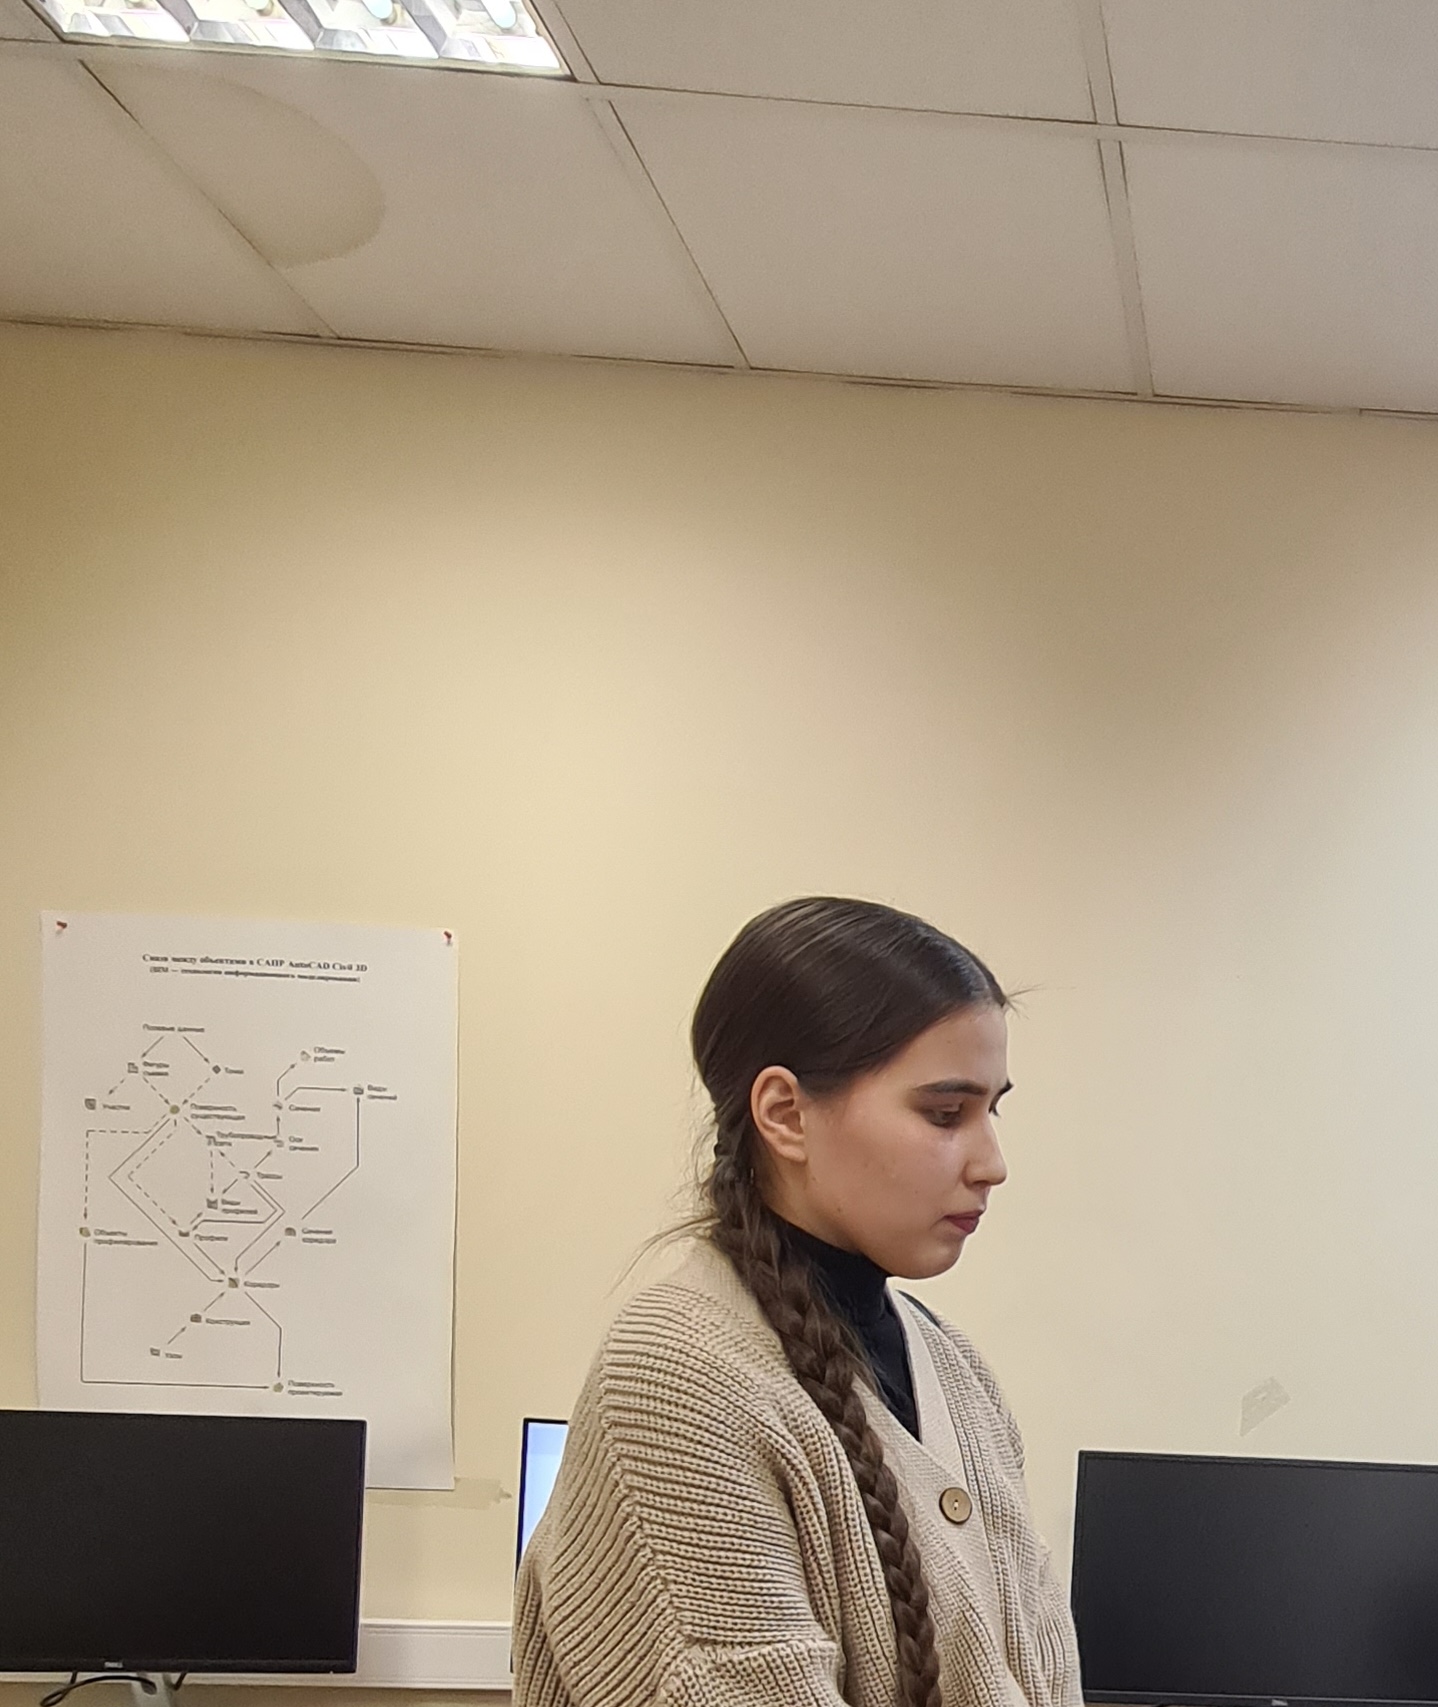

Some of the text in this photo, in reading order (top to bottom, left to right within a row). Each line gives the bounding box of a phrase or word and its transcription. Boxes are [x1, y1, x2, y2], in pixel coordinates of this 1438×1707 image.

[256, 958, 285, 967] САПР
[289, 960, 330, 969] AutoCAD
[332, 962, 353, 970] Civil
